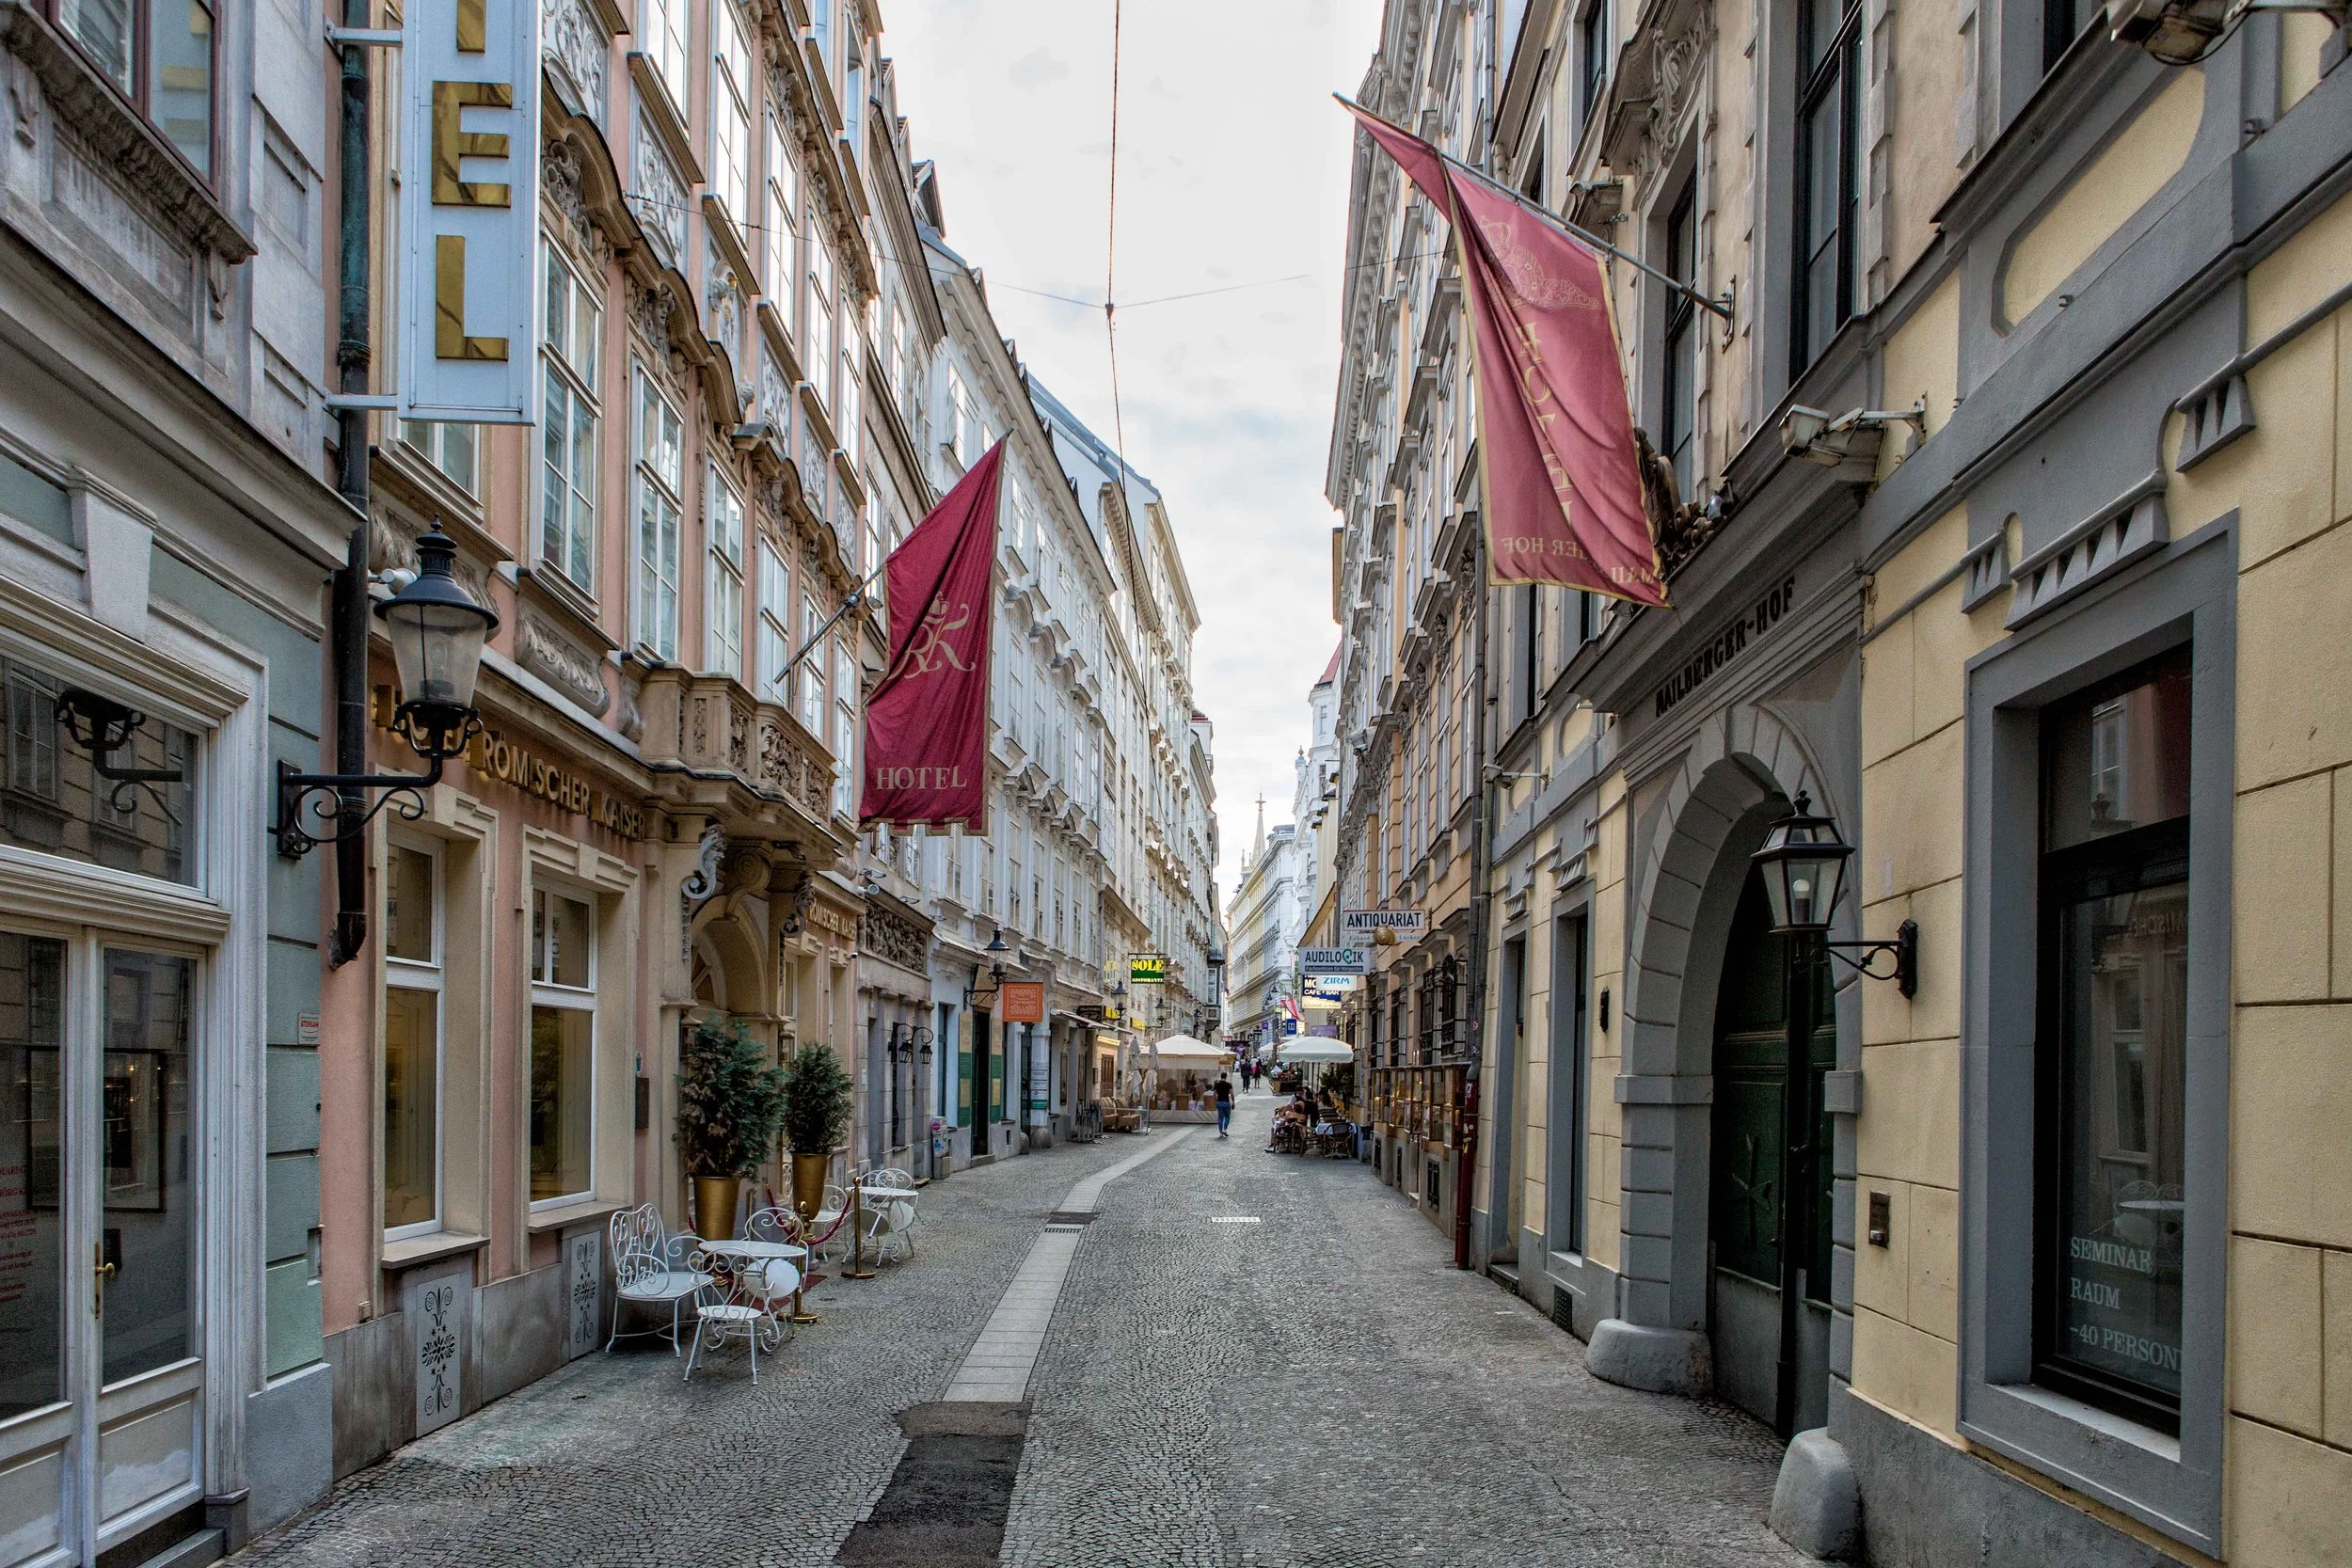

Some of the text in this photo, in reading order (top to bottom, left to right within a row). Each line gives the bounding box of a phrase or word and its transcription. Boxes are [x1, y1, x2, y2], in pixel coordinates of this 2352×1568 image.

[876, 765, 968, 791] HOTEL
[1346, 911, 1422, 927] ANTIQUARIAT
[1132, 959, 1165, 971] SOLE
[2071, 1236, 2152, 1273] SEMINAR
[2071, 1276, 2122, 1310] RAUM
[2103, 1327, 2183, 1371] PERSON
